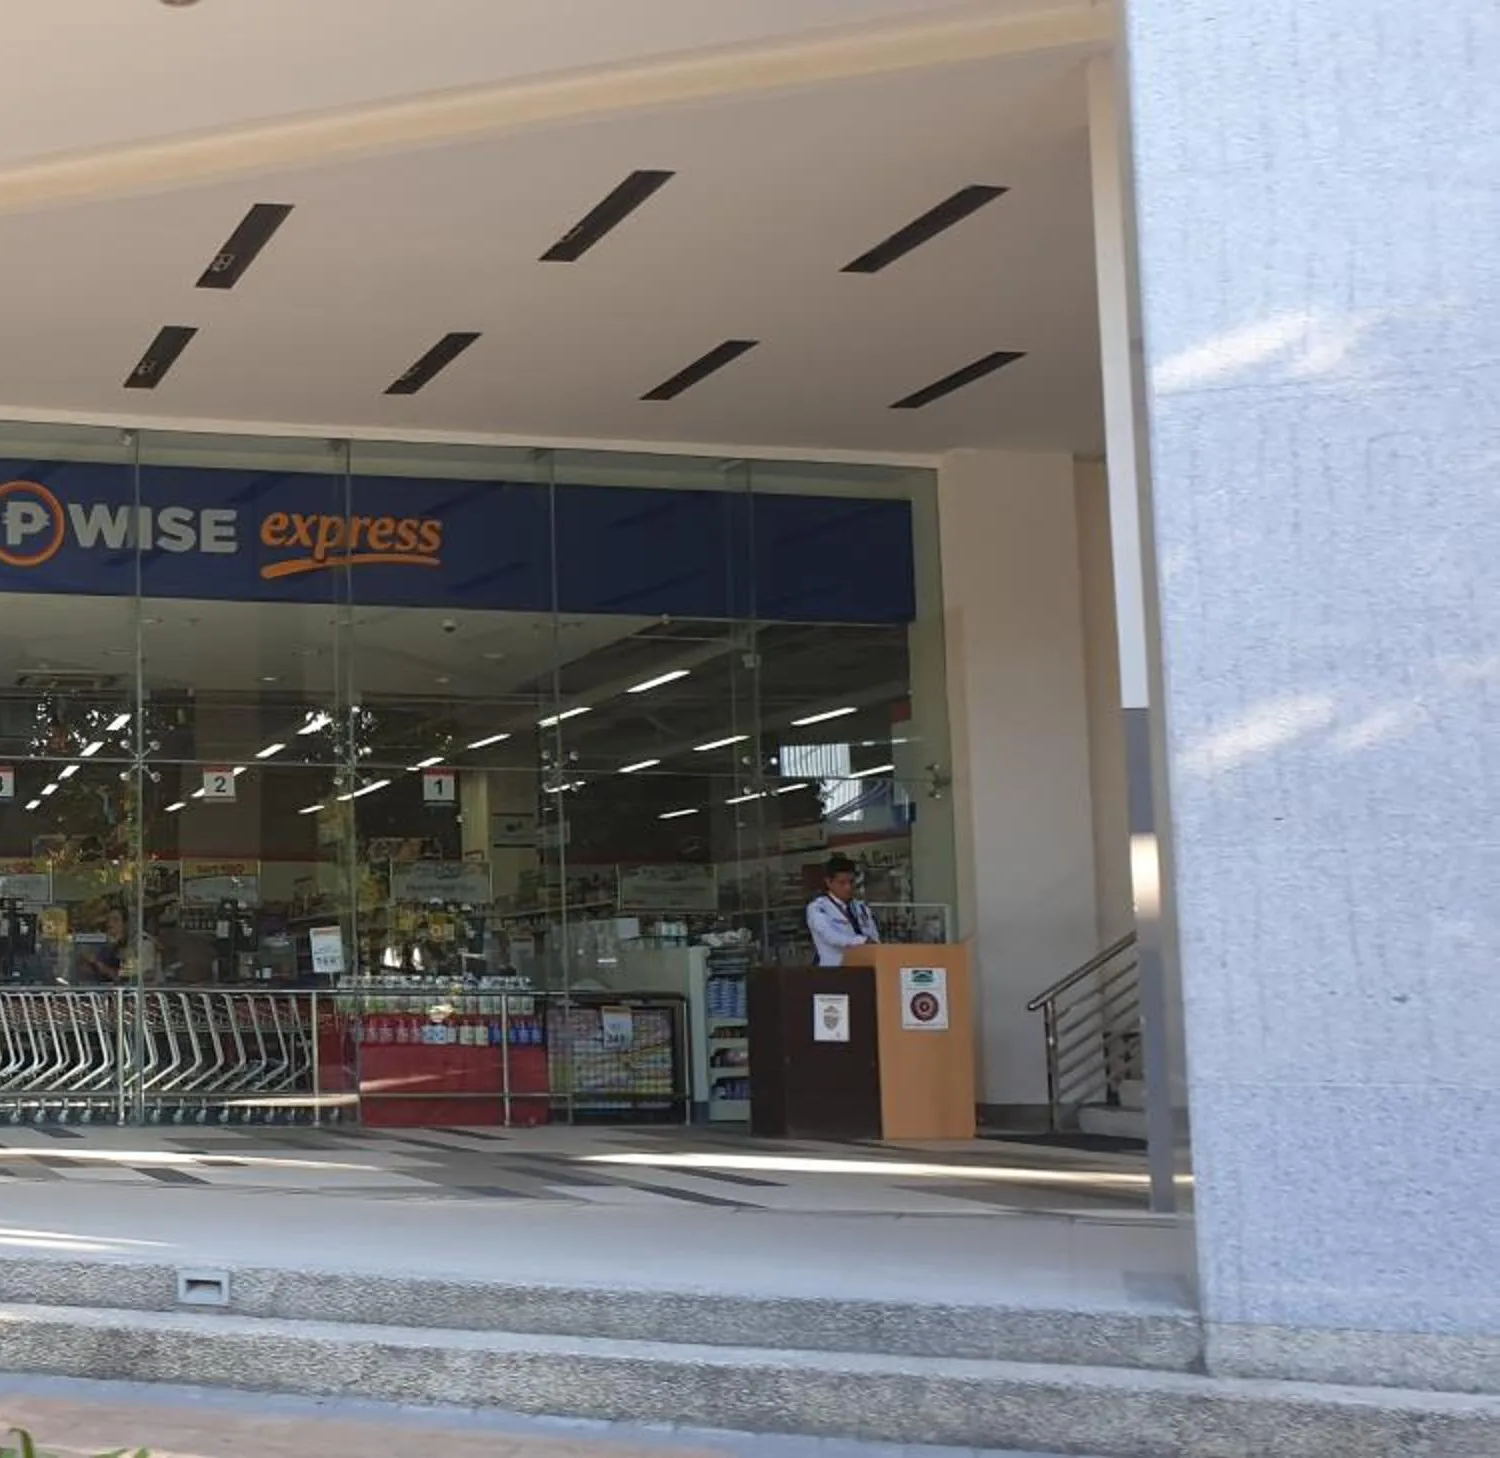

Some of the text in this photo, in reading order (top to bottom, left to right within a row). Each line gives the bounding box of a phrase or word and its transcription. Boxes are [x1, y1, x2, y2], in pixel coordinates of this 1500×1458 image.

[260, 507, 442, 562] express
[213, 775, 227, 793] 2
[432, 778, 443, 796] 1
